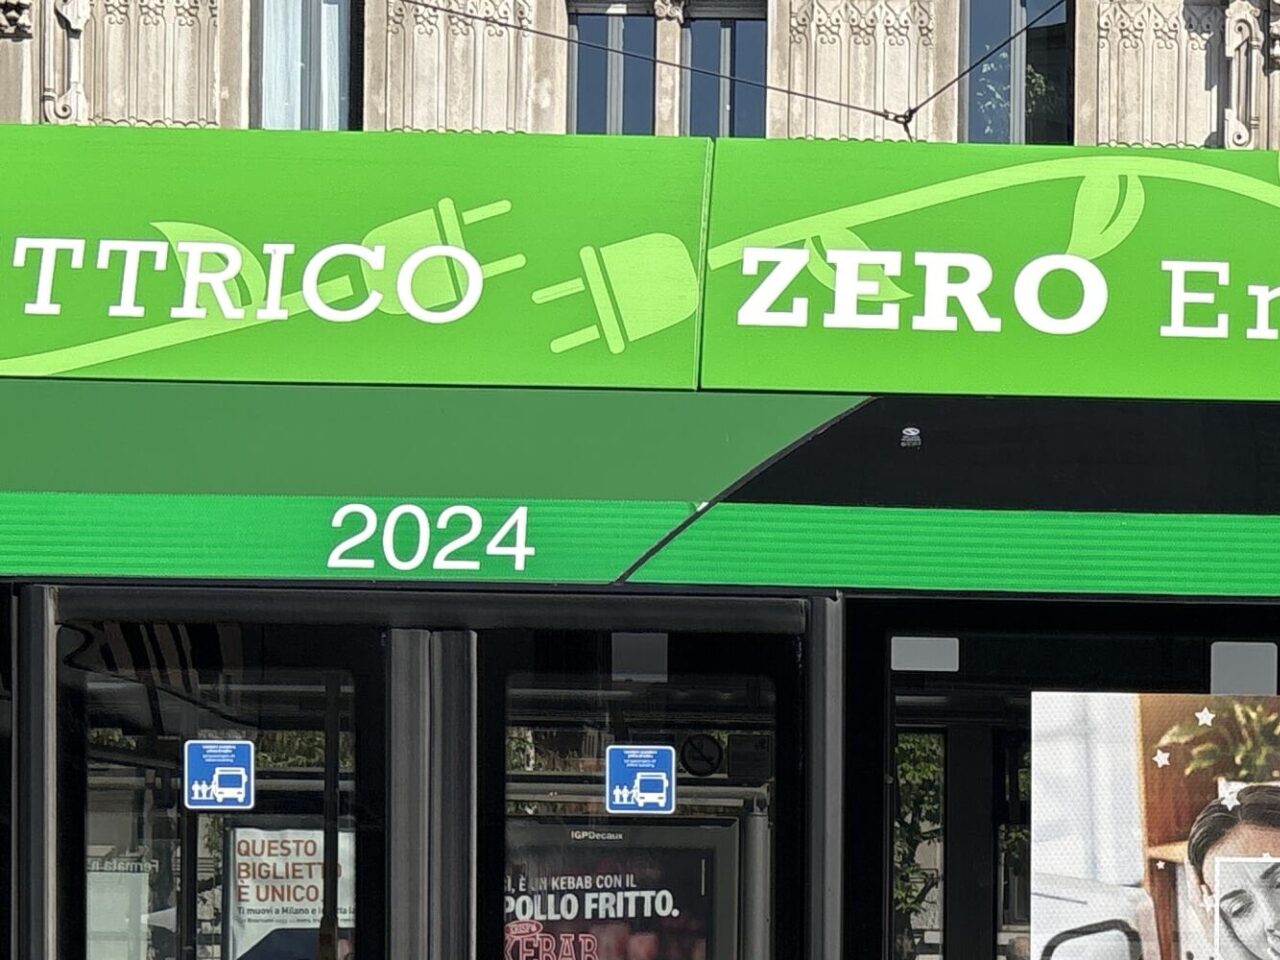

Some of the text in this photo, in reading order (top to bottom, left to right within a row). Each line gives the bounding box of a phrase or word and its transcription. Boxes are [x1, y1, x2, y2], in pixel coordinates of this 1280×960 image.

[13, 237, 483, 324] TTRICO
[737, 246, 1109, 335] ZERO
[327, 504, 536, 571] 2024
[571, 831, 624, 840] IGPDecaux
[237, 839, 318, 857] QUESTO
[237, 880, 250, 902] È
[551, 875, 593, 890] KEBAB
[596, 875, 622, 889] CON
[625, 874, 637, 888] IL
[281, 906, 310, 915] Milano
[585, 890, 680, 919] FRITTO.
